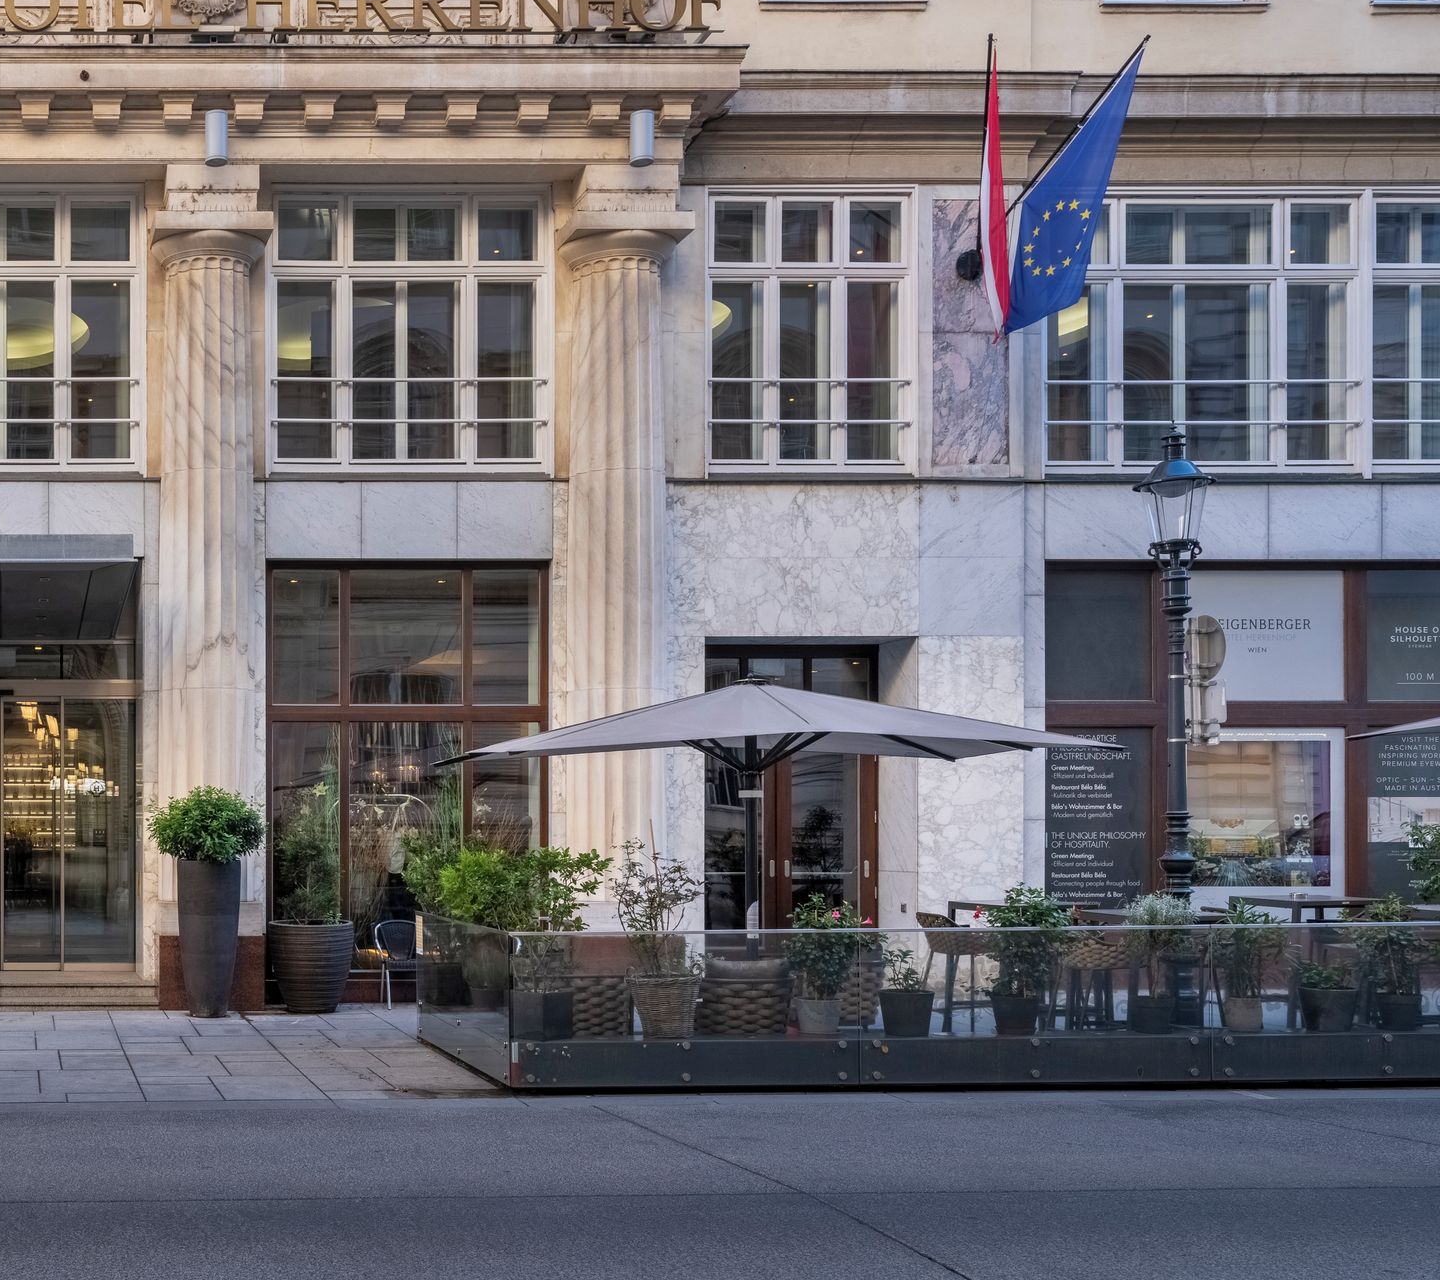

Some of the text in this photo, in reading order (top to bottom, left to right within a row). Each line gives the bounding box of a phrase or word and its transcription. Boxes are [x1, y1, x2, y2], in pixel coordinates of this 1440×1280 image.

[1219, 618, 1312, 630] EIGENBERGER
[1395, 626, 1428, 634] HOUSE
[1406, 672, 1435, 681] 100 M
[1051, 752, 1132, 760] GASTFREUNDSCHAFT.
[1069, 764, 1095, 772] Meetings
[1051, 832, 1147, 840] THE UNIQUE PHILOSOPHY
[1051, 841, 1111, 849] OF HOSPITALITY.
[1069, 852, 1095, 860] Meetings
[1085, 880, 1105, 888] people
[1106, 880, 1126, 888] through
